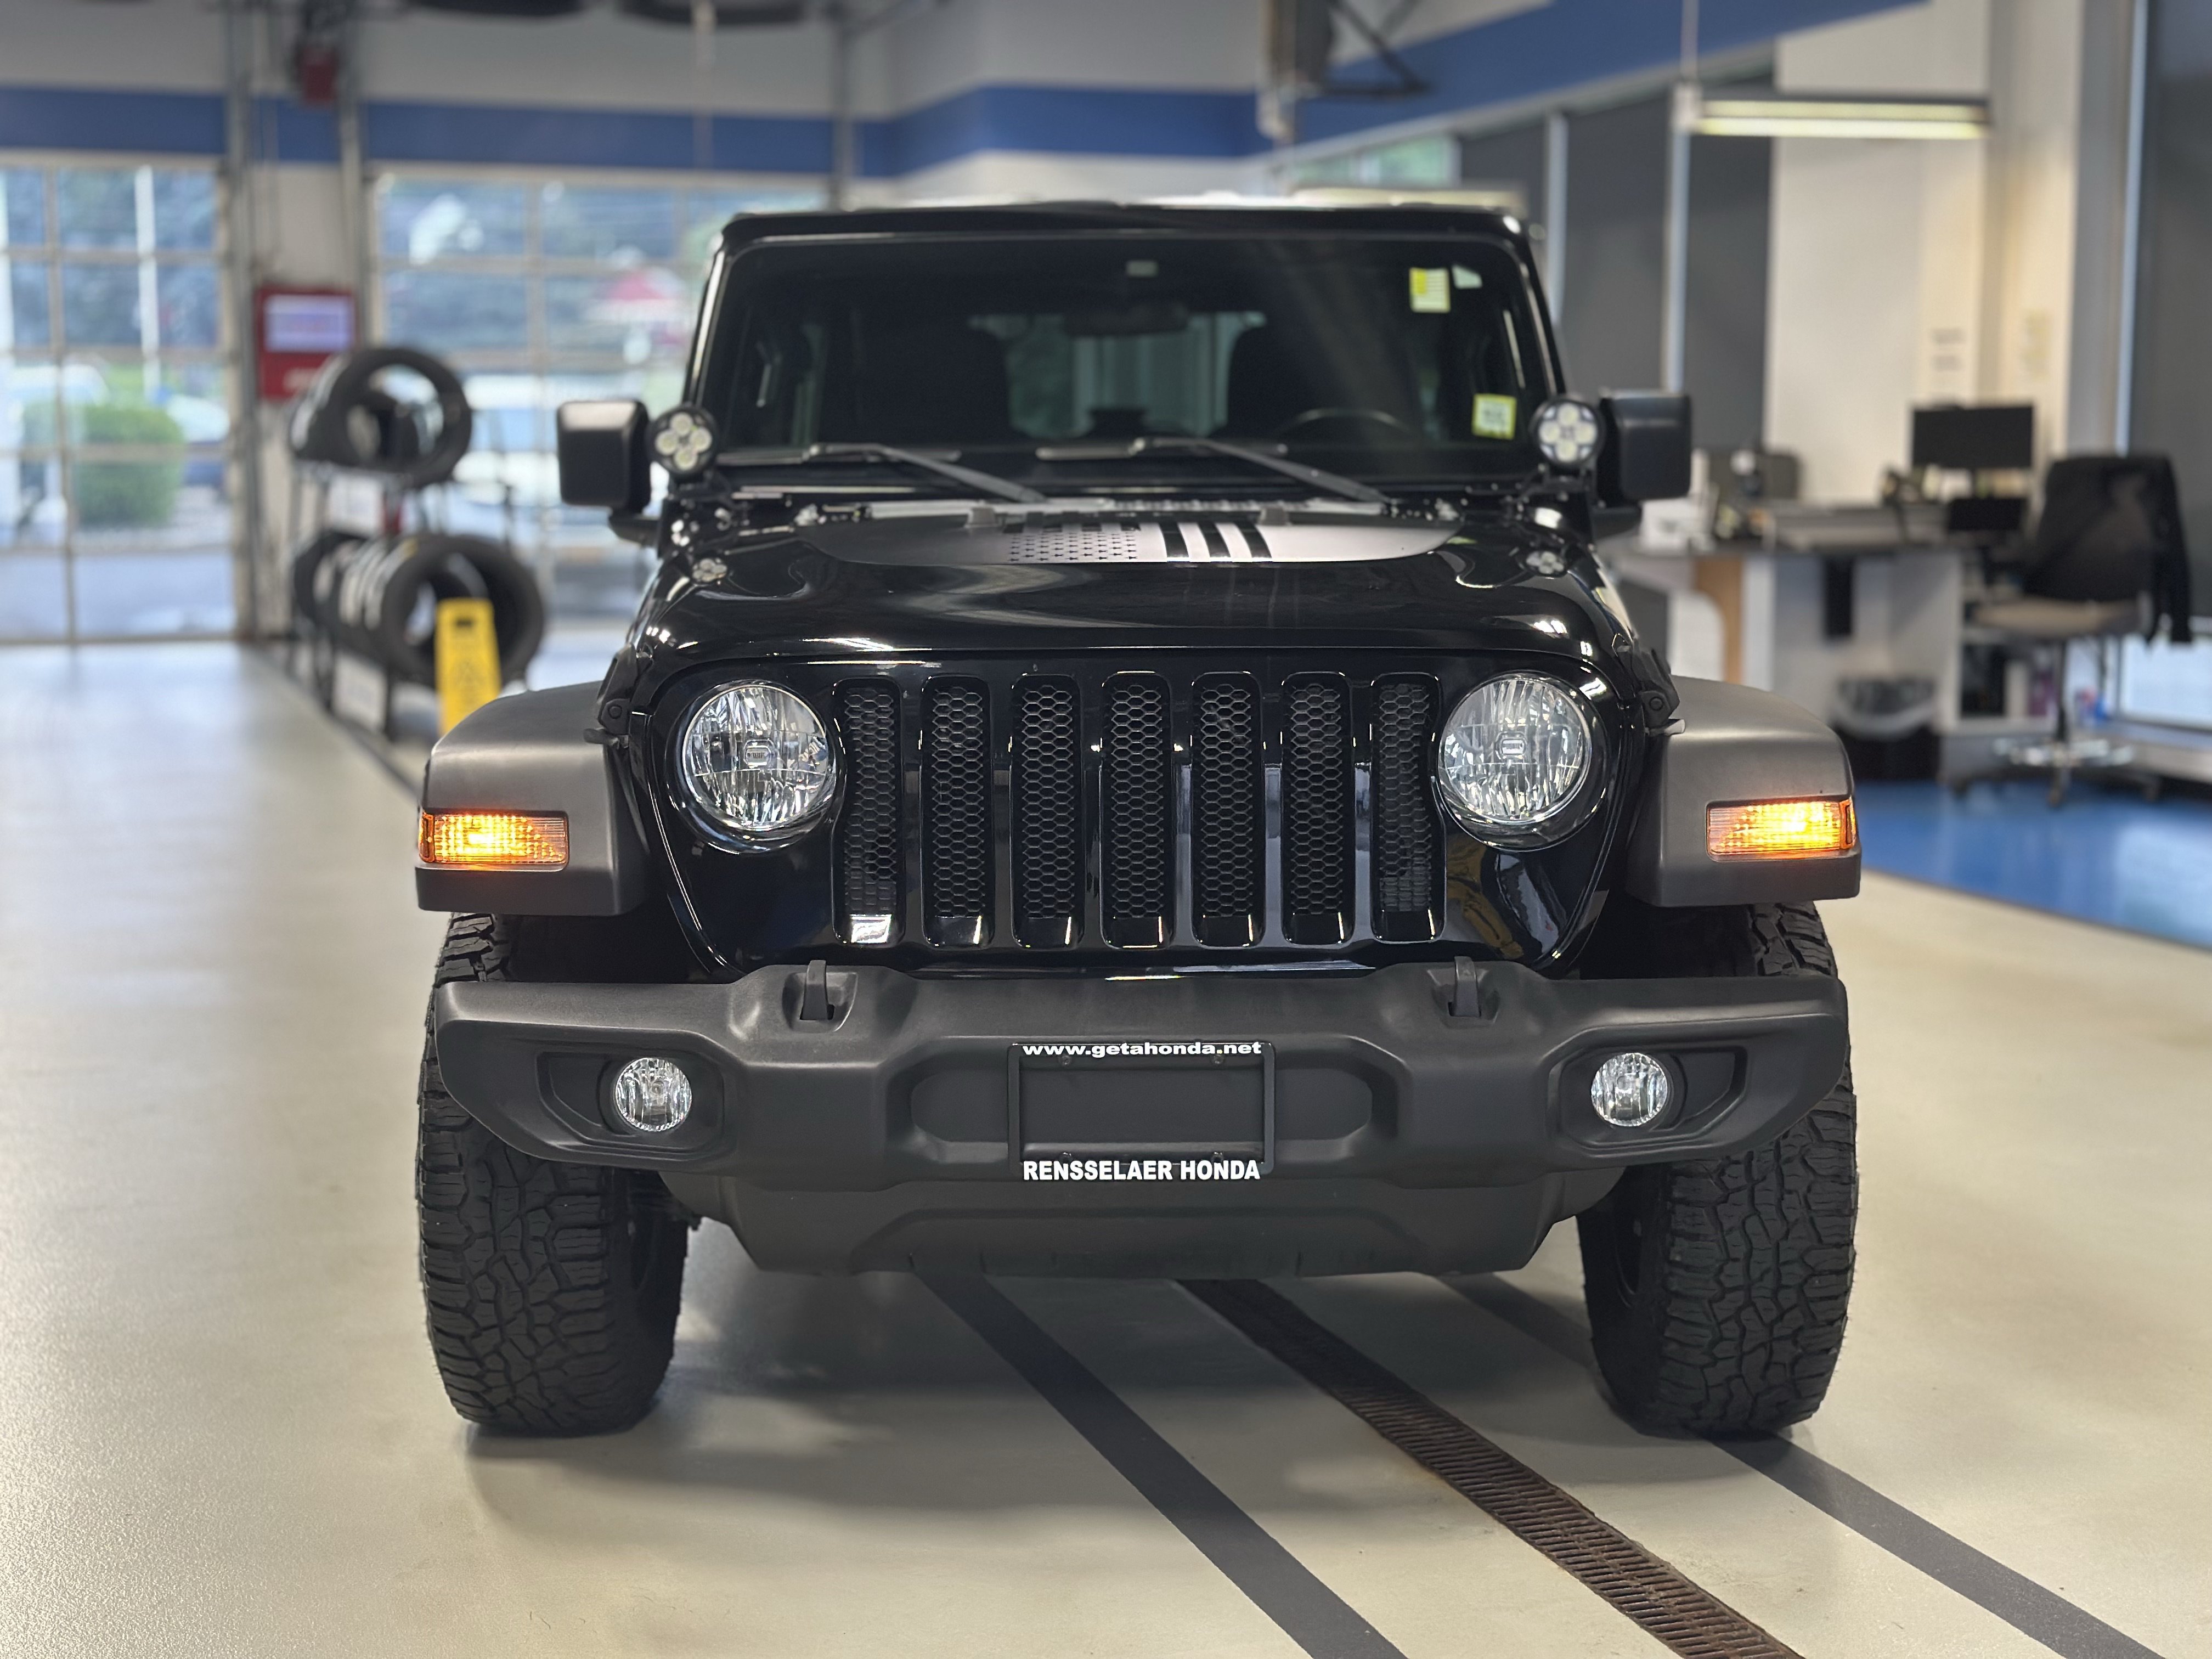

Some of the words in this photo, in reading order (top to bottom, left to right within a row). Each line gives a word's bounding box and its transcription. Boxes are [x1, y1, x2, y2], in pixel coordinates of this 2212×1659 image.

[1022, 1042, 1262, 1058] www.getahonda.net
[1023, 1160, 1173, 1181] RENSSELAER
[1180, 1160, 1261, 1180] HONDA
